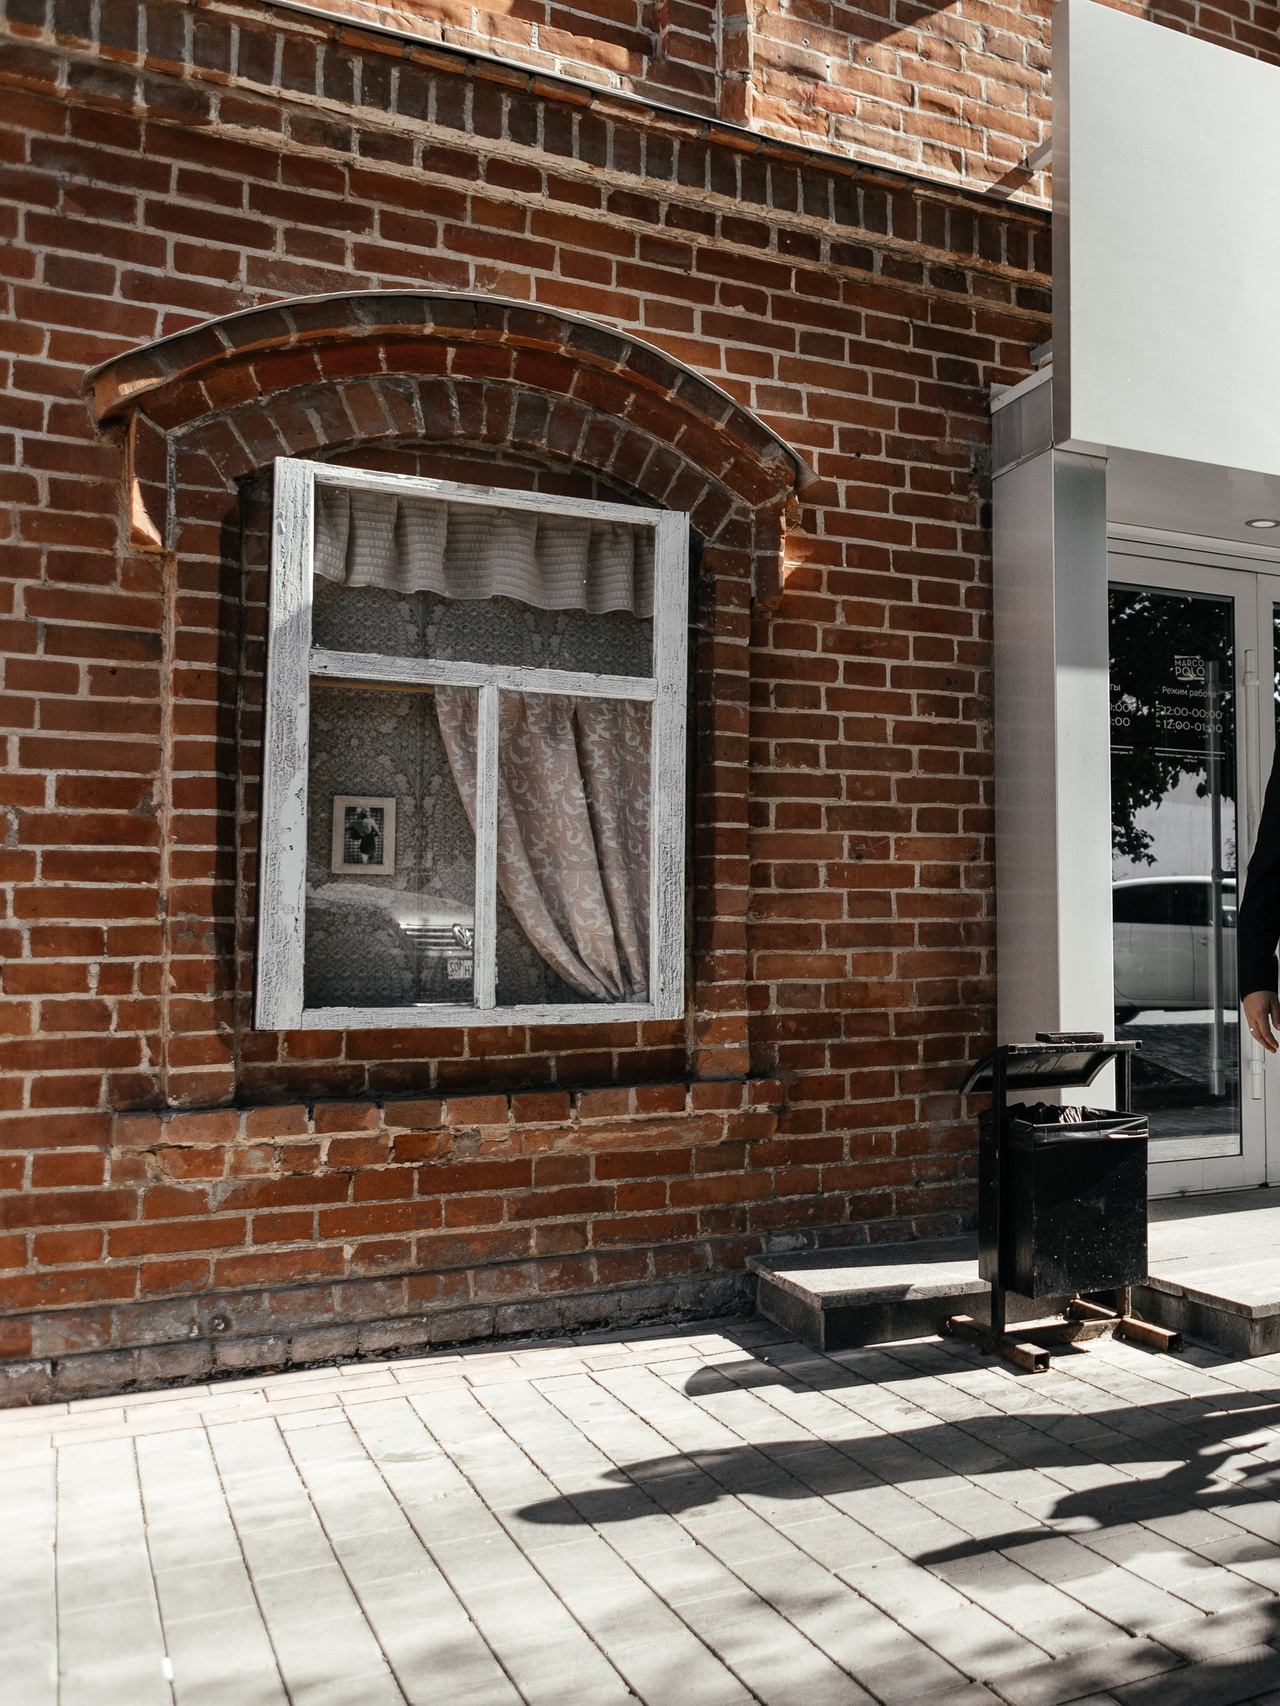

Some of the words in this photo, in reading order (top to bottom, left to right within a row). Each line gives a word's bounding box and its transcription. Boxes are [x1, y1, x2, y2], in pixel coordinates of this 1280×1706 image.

[1174, 659, 1205, 667] MARCO
[1175, 666, 1206, 676] POLO
[1162, 685, 1188, 696] Режим
[1189, 688, 1217, 698] работы
[1163, 705, 1223, 719] 12:00-00:00
[1163, 719, 1223, 733] 12:00-01:00
